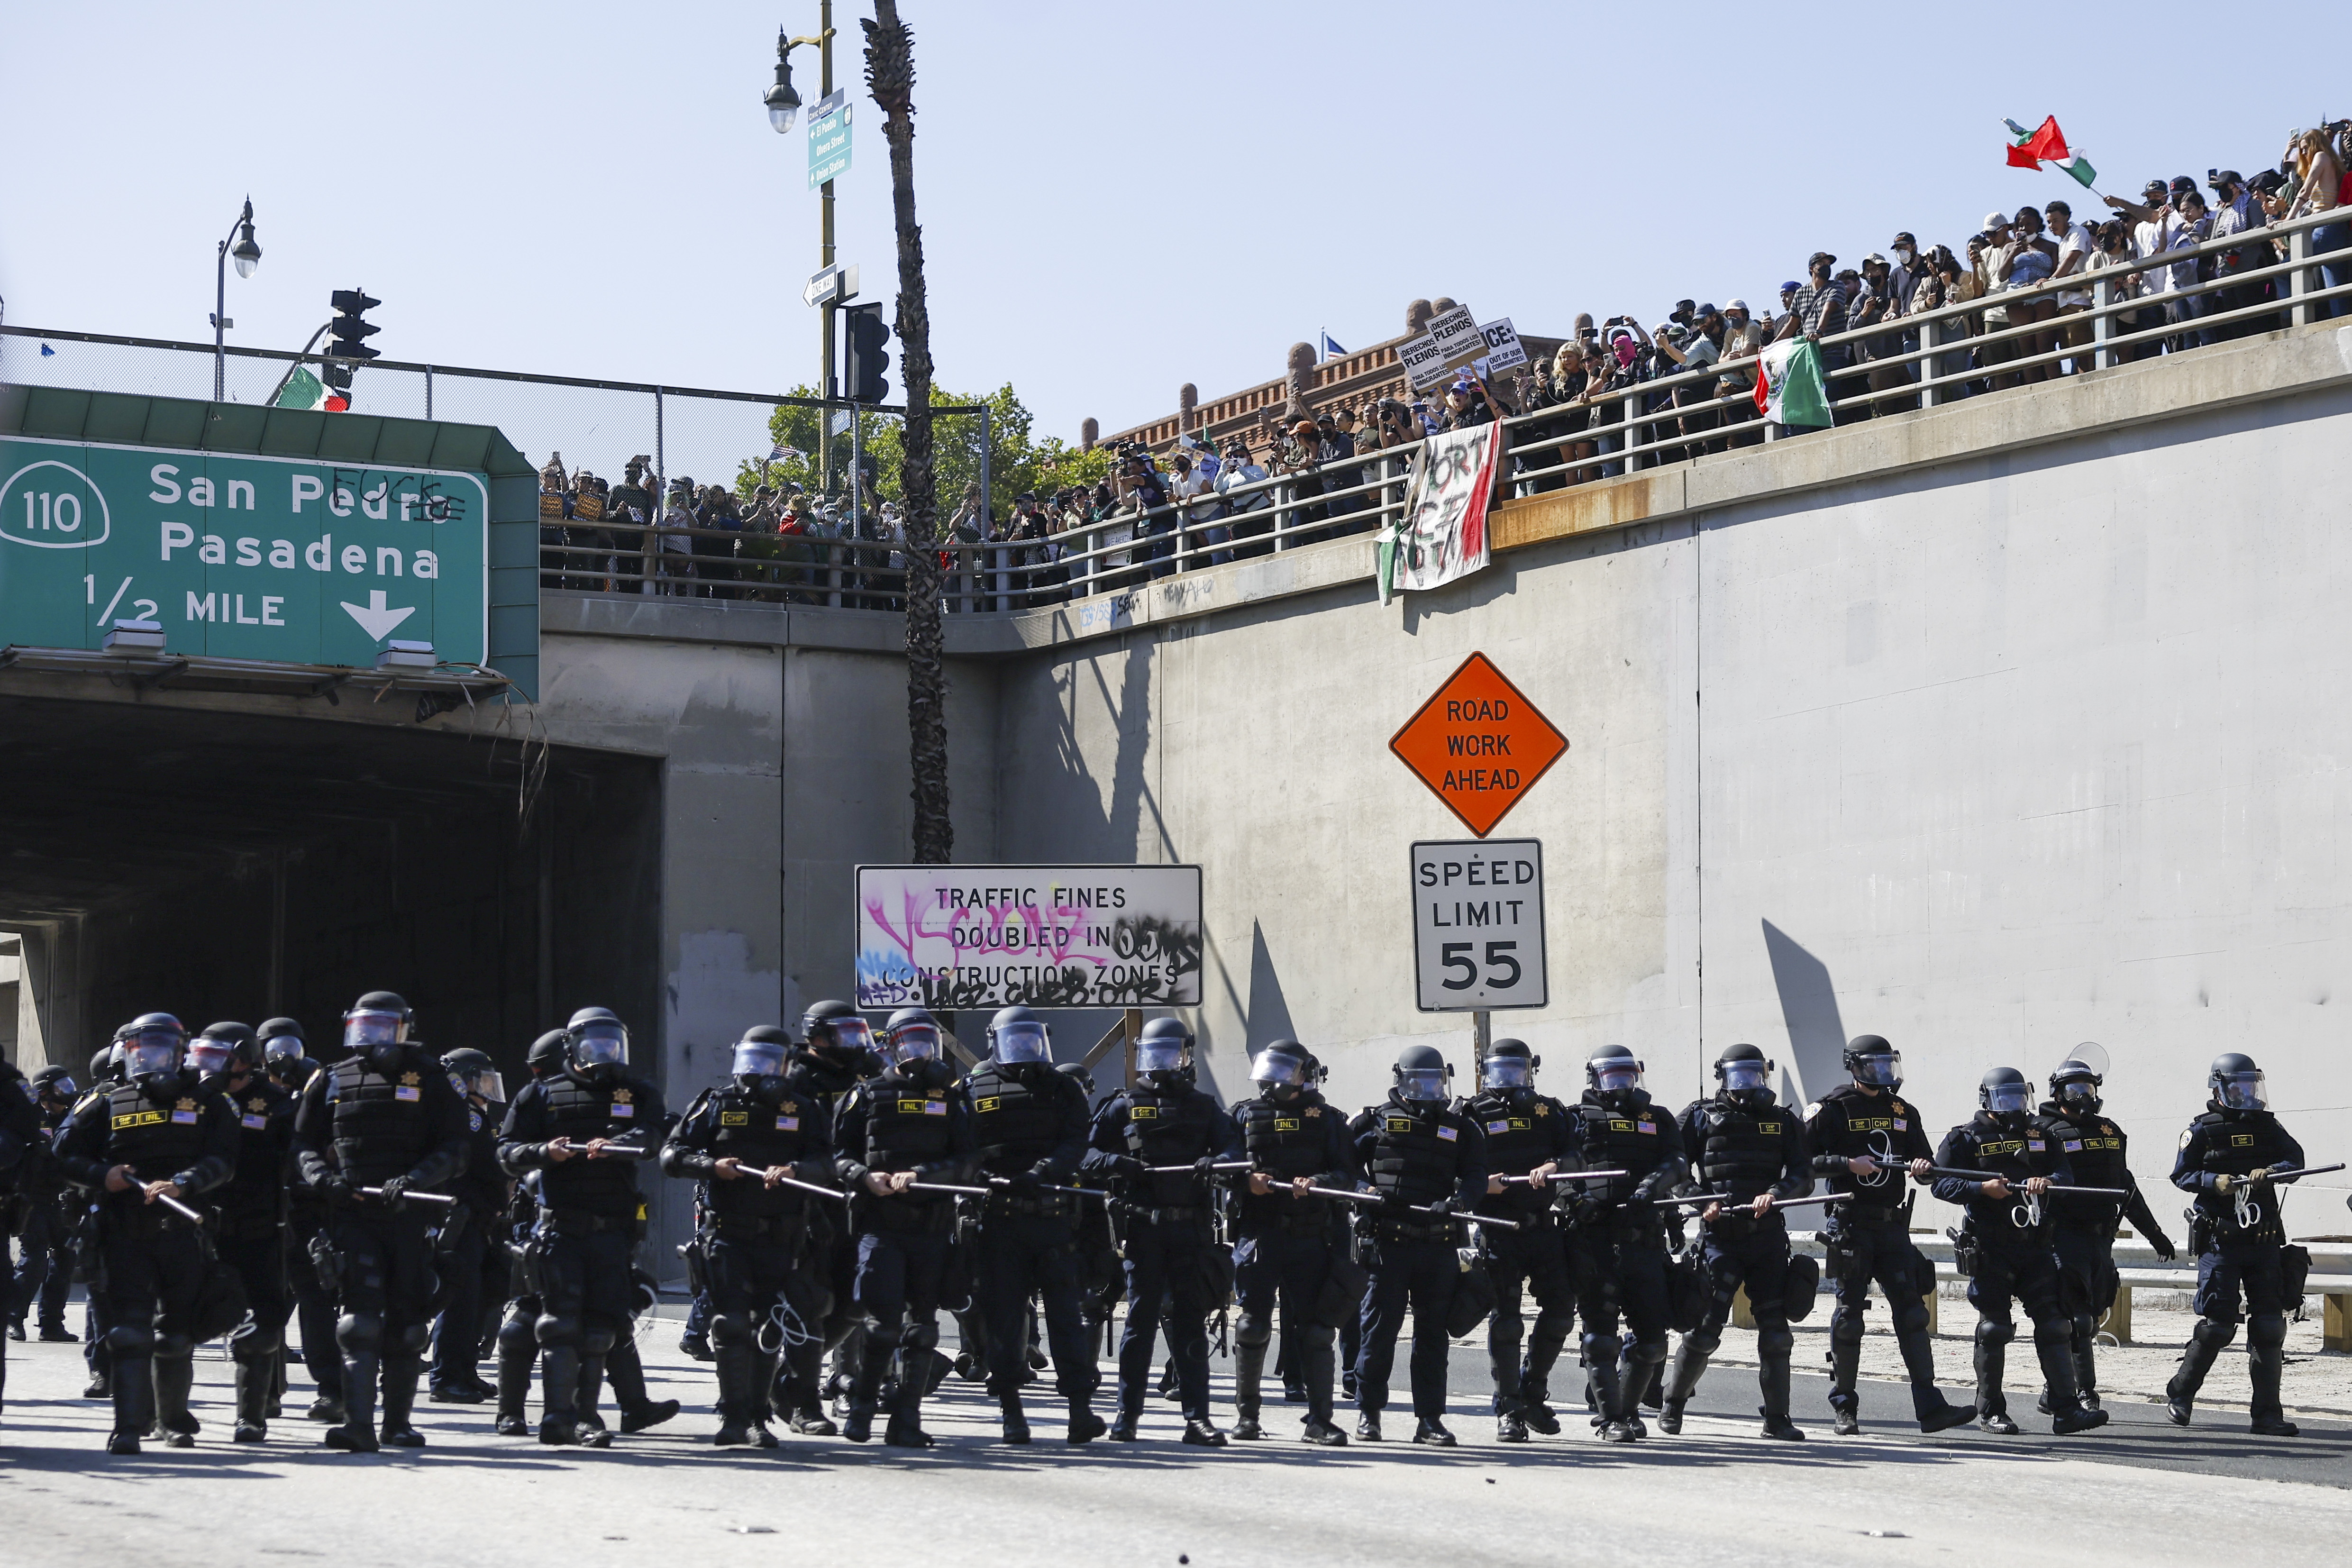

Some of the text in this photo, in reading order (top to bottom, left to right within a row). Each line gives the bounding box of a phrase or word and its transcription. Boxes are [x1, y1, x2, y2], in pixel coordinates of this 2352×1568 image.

[809, 102, 833, 121] CIVIC CENTER
[817, 117, 837, 137] El Pueblo
[817, 131, 845, 157] Olvera Street
[816, 158, 845, 181] Union Station
[812, 275, 833, 297] ONE WAY
[1433, 318, 1472, 342] PLENOS
[1480, 325, 1515, 350] ICE:
[1440, 345, 1454, 354] PARA
[1454, 337, 1469, 348] TODOS
[1443, 339, 1482, 360] INMIGRANTES!
[1489, 355, 1502, 364] OUT
[1510, 348, 1522, 357] OUR
[1404, 346, 1440, 368] PLENOS
[1492, 355, 1525, 370] COMMUNITIES!
[1412, 372, 1425, 381] PARA
[1424, 366, 1440, 376] TODOS
[1415, 369, 1452, 387] INMIGRANTES
[148, 463, 451, 524] San Pedro
[333, 467, 441, 509] FUCK
[23, 490, 82, 533] 110
[406, 495, 466, 522] ICE
[161, 521, 438, 579] Pasadena
[83, 574, 158, 626] 1/2
[186, 591, 285, 626] MILE
[1447, 700, 1509, 721] ROAD
[1447, 735, 1512, 757] WORK
[1442, 768, 1520, 791] AHEAD
[1420, 860, 1535, 887] SPEED
[935, 887, 1037, 909] TRAFFIC
[1054, 887, 1126, 909] FINES
[1433, 901, 1523, 927] LIMIT
[952, 927, 1070, 948] DOUBLED
[1087, 926, 1111, 947] IN
[882, 965, 1178, 987] CONSTRUCTION ZONES
[1441, 941, 1522, 991] 55
[145, 1113, 162, 1121] INL
[727, 1114, 745, 1122] CHP
[1280, 1121, 1294, 1129] INL
[1513, 1120, 1526, 1128] INL
